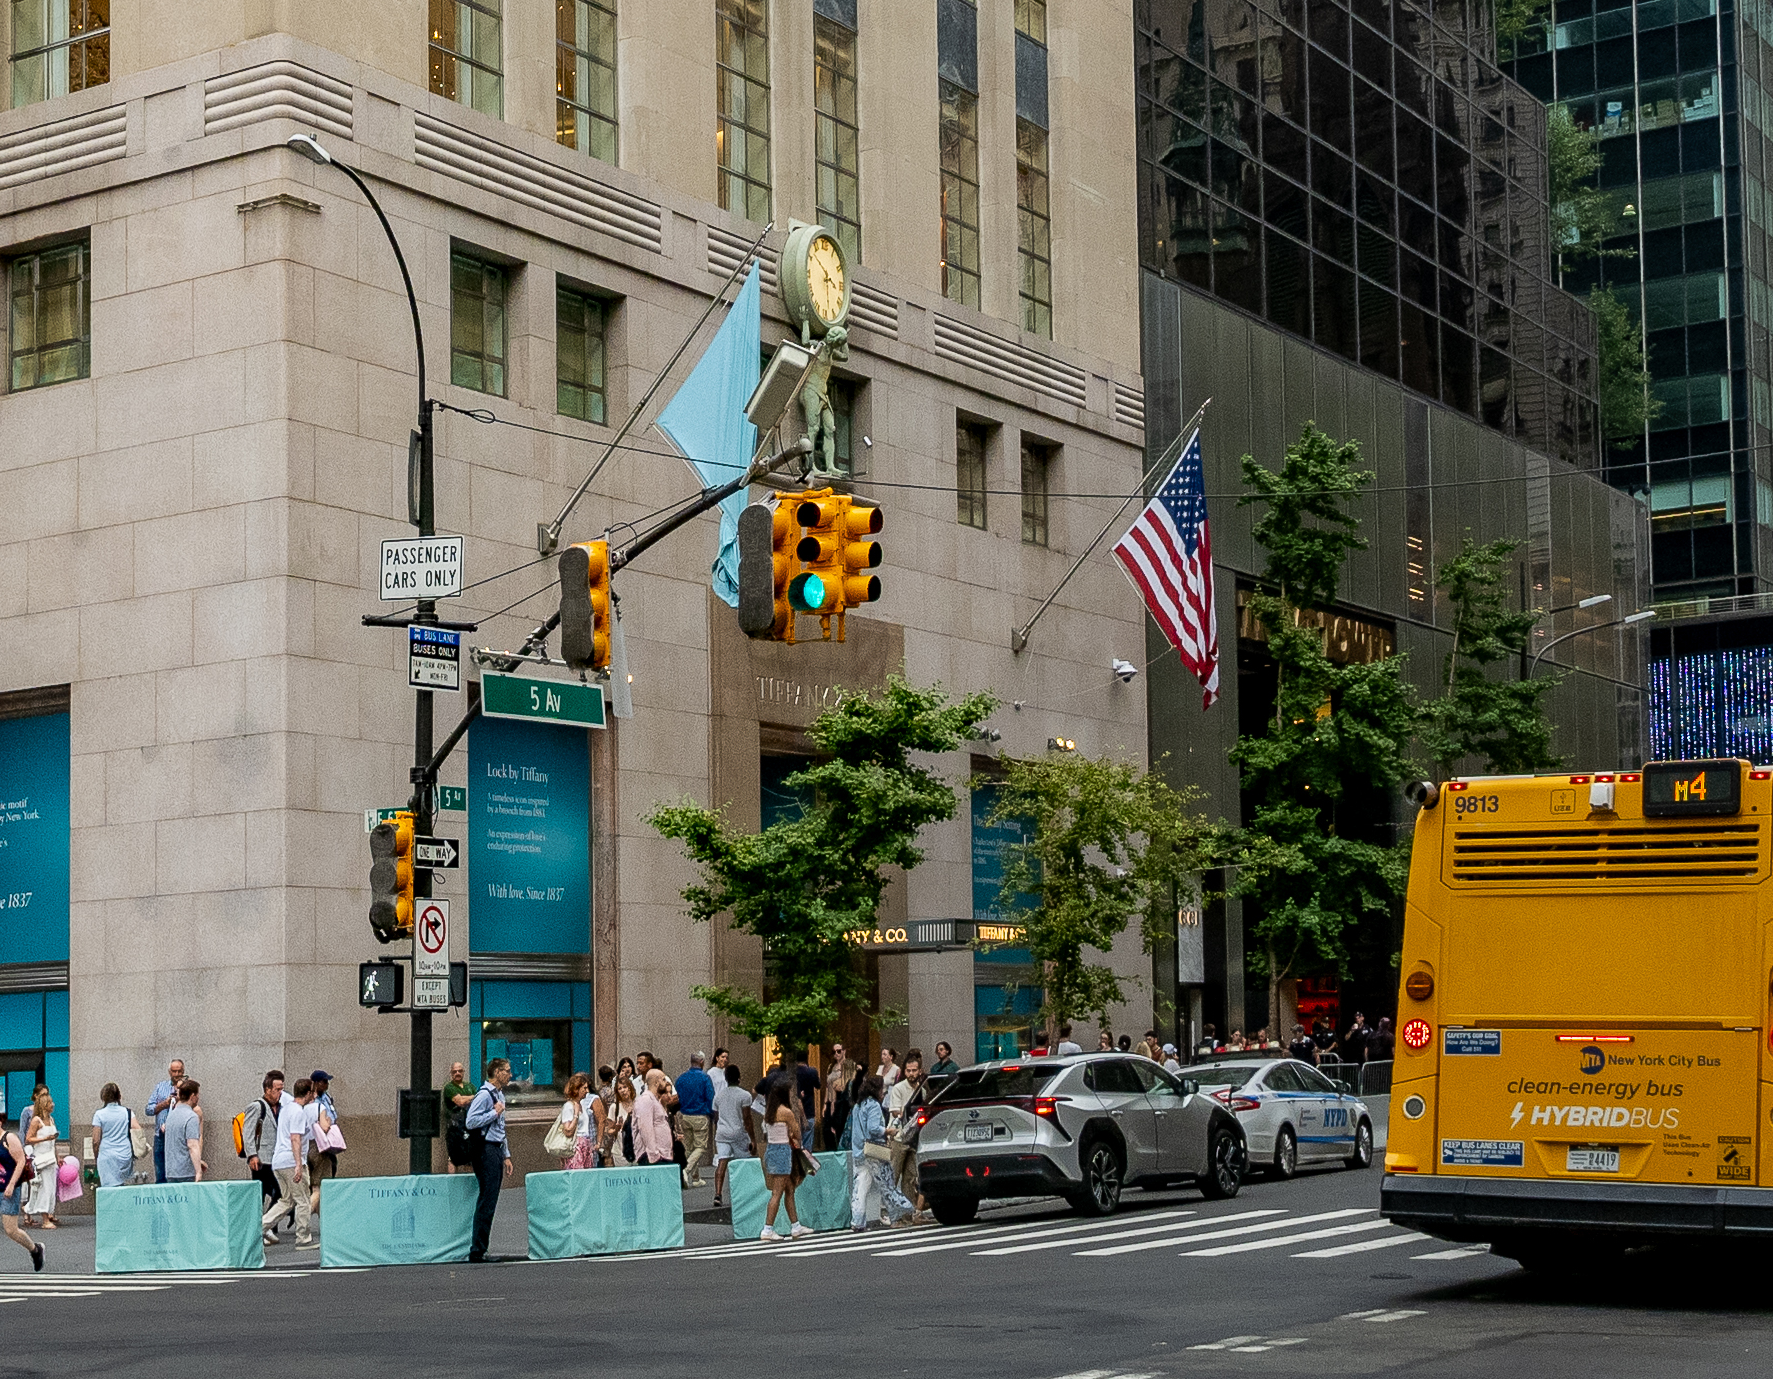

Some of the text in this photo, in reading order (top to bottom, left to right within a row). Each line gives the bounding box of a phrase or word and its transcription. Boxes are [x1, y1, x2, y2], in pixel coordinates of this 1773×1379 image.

[386, 546, 457, 565] PASSENGER
[385, 569, 456, 589] CARS ONLY
[424, 631, 455, 643] BUS LANE
[413, 643, 456, 657] BUSES ONLY
[530, 686, 561, 712] 5 Av
[488, 763, 549, 787] Lock by Tiffany
[1674, 771, 1707, 802] M4
[8, 797, 28, 809] motif
[445, 790, 451, 807] 5
[1454, 795, 1499, 813] 9813
[6, 812, 21, 822] New
[420, 846, 451, 859] ONE WAY
[488, 883, 507, 899] With
[526, 886, 545, 900] Since
[546, 887, 564, 901] 1837
[8, 892, 32, 908] 1837
[873, 930, 883, 943] &
[885, 929, 908, 942] CO.
[422, 981, 441, 990] EXCEPT
[429, 995, 446, 1003] BUSES
[1580, 1053, 1603, 1068] MTA
[1608, 1055, 1721, 1068] New York City Bus
[1507, 1077, 1683, 1100] clean-energy bus
[1324, 1108, 1347, 1127] NYPD
[1719, 1166, 1748, 1175] WIDE
